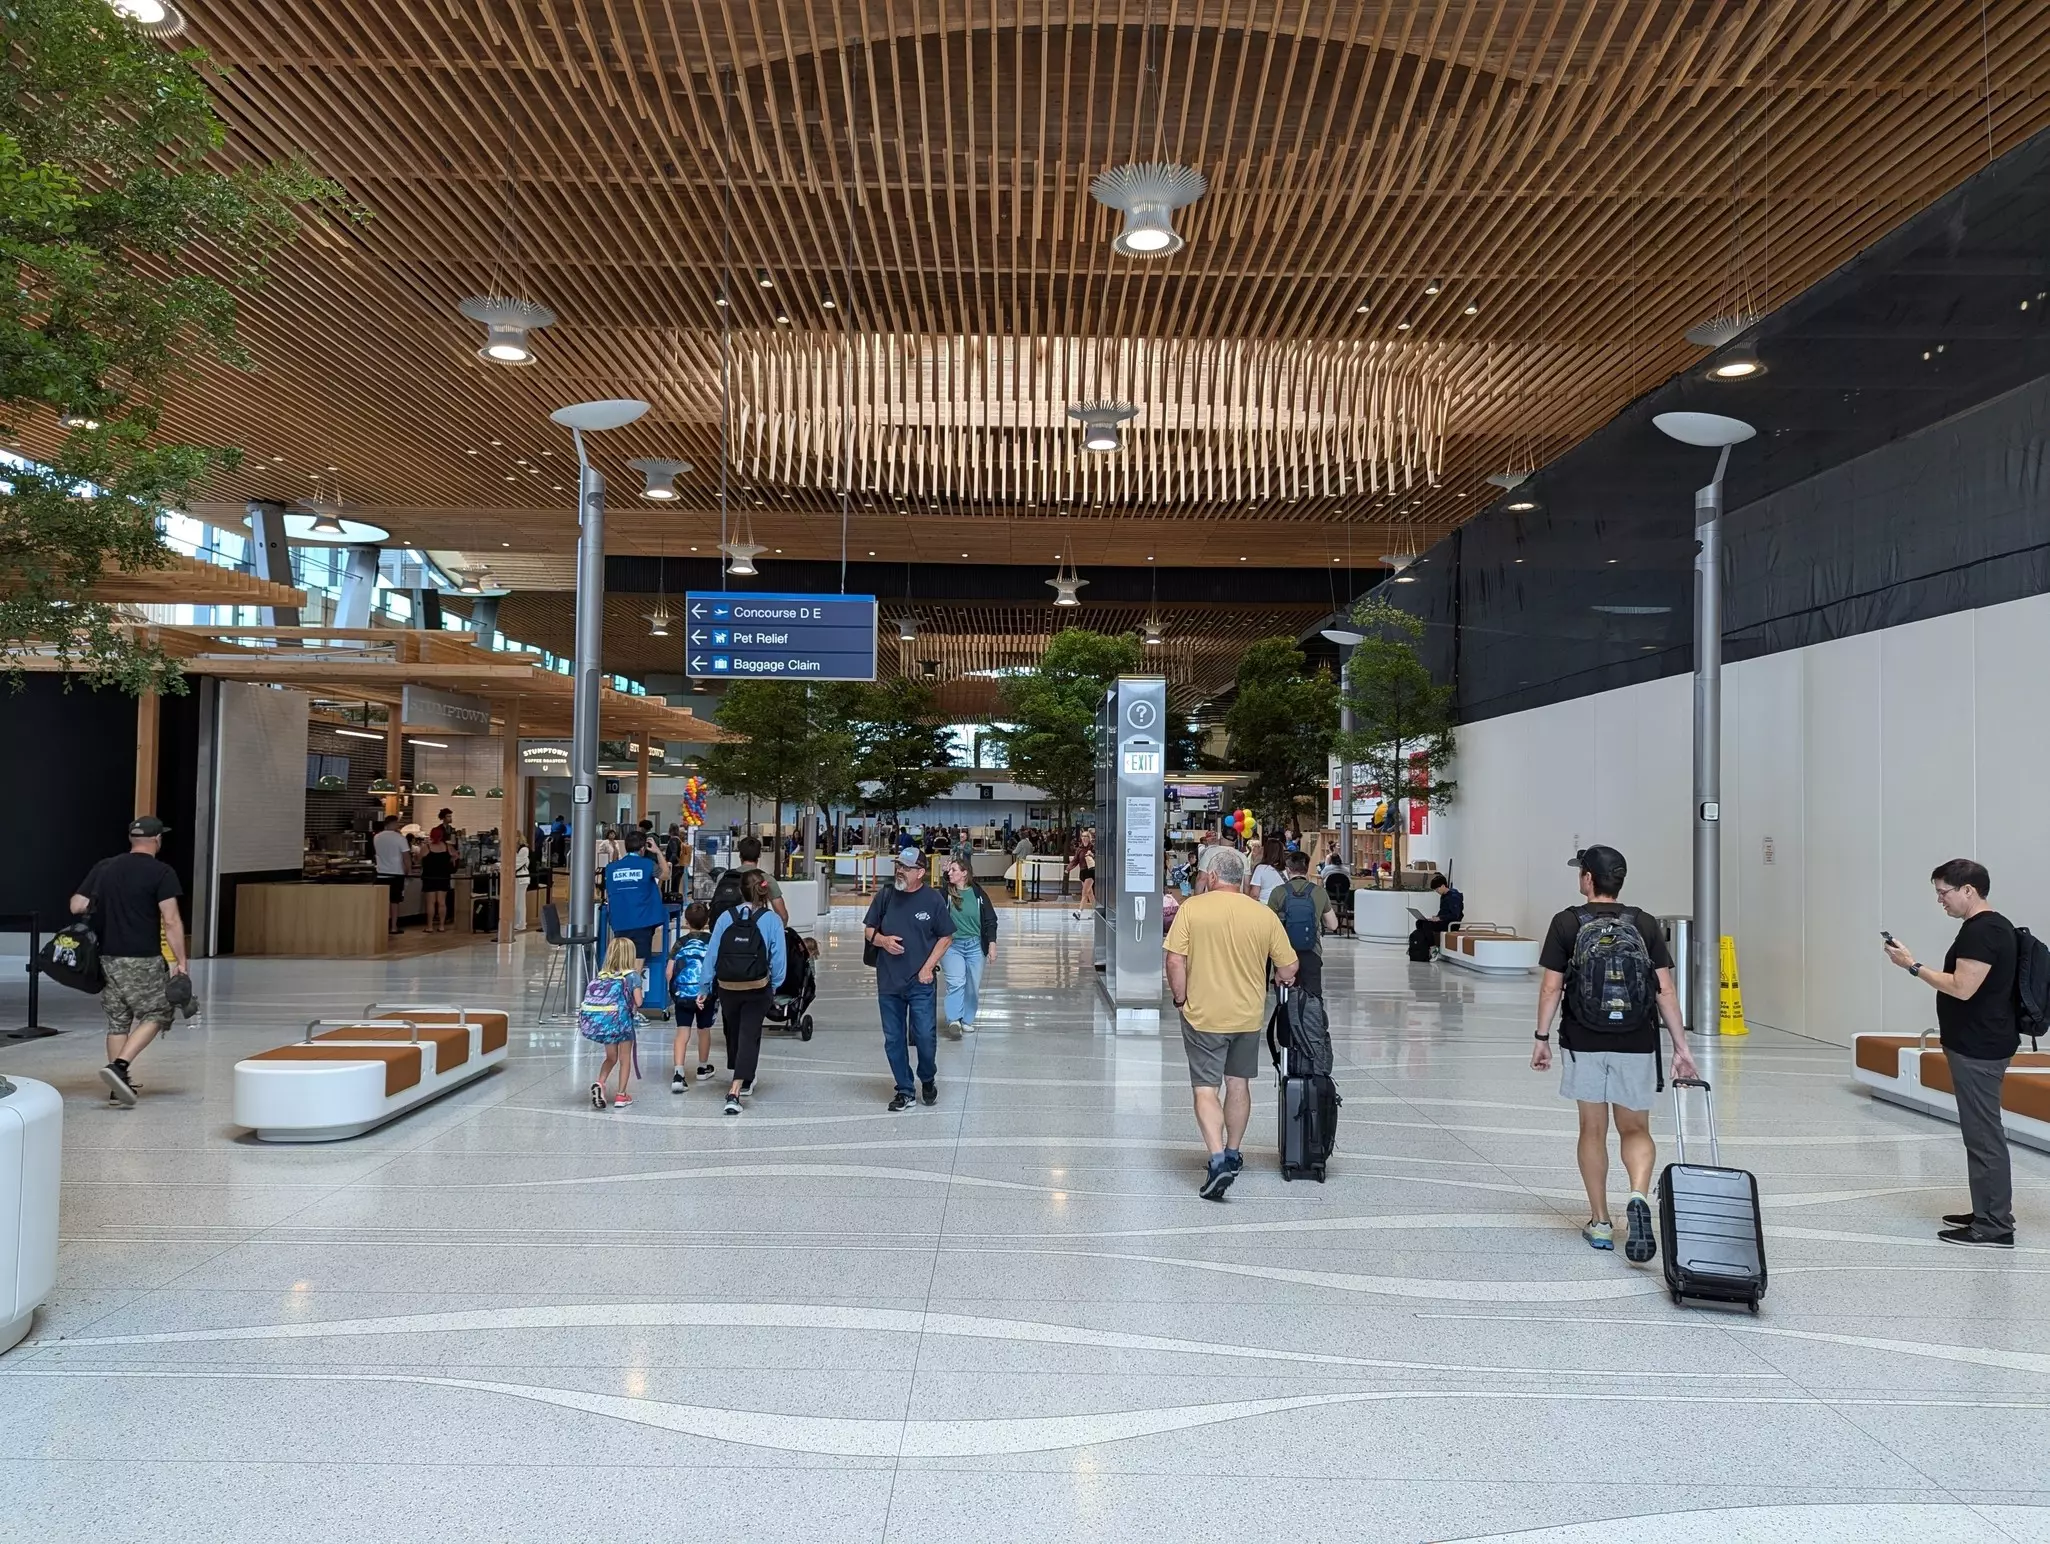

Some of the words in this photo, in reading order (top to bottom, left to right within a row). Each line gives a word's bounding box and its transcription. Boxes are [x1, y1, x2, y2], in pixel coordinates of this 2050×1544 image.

[734, 607, 797, 619] Concourse
[800, 608, 809, 619] D
[813, 608, 821, 619] E
[734, 632, 752, 644] Pet
[756, 633, 789, 645] Relief
[734, 658, 785, 672] Baggage
[788, 659, 821, 671] Claim
[409, 700, 490, 723] STUMPTOWN
[522, 747, 569, 757] STUMPTOWN
[1131, 754, 1154, 771] EXIT
[607, 782, 619, 792] 10
[983, 788, 990, 797] 6
[1167, 791, 1174, 799] 4
[614, 871, 628, 879] ASK
